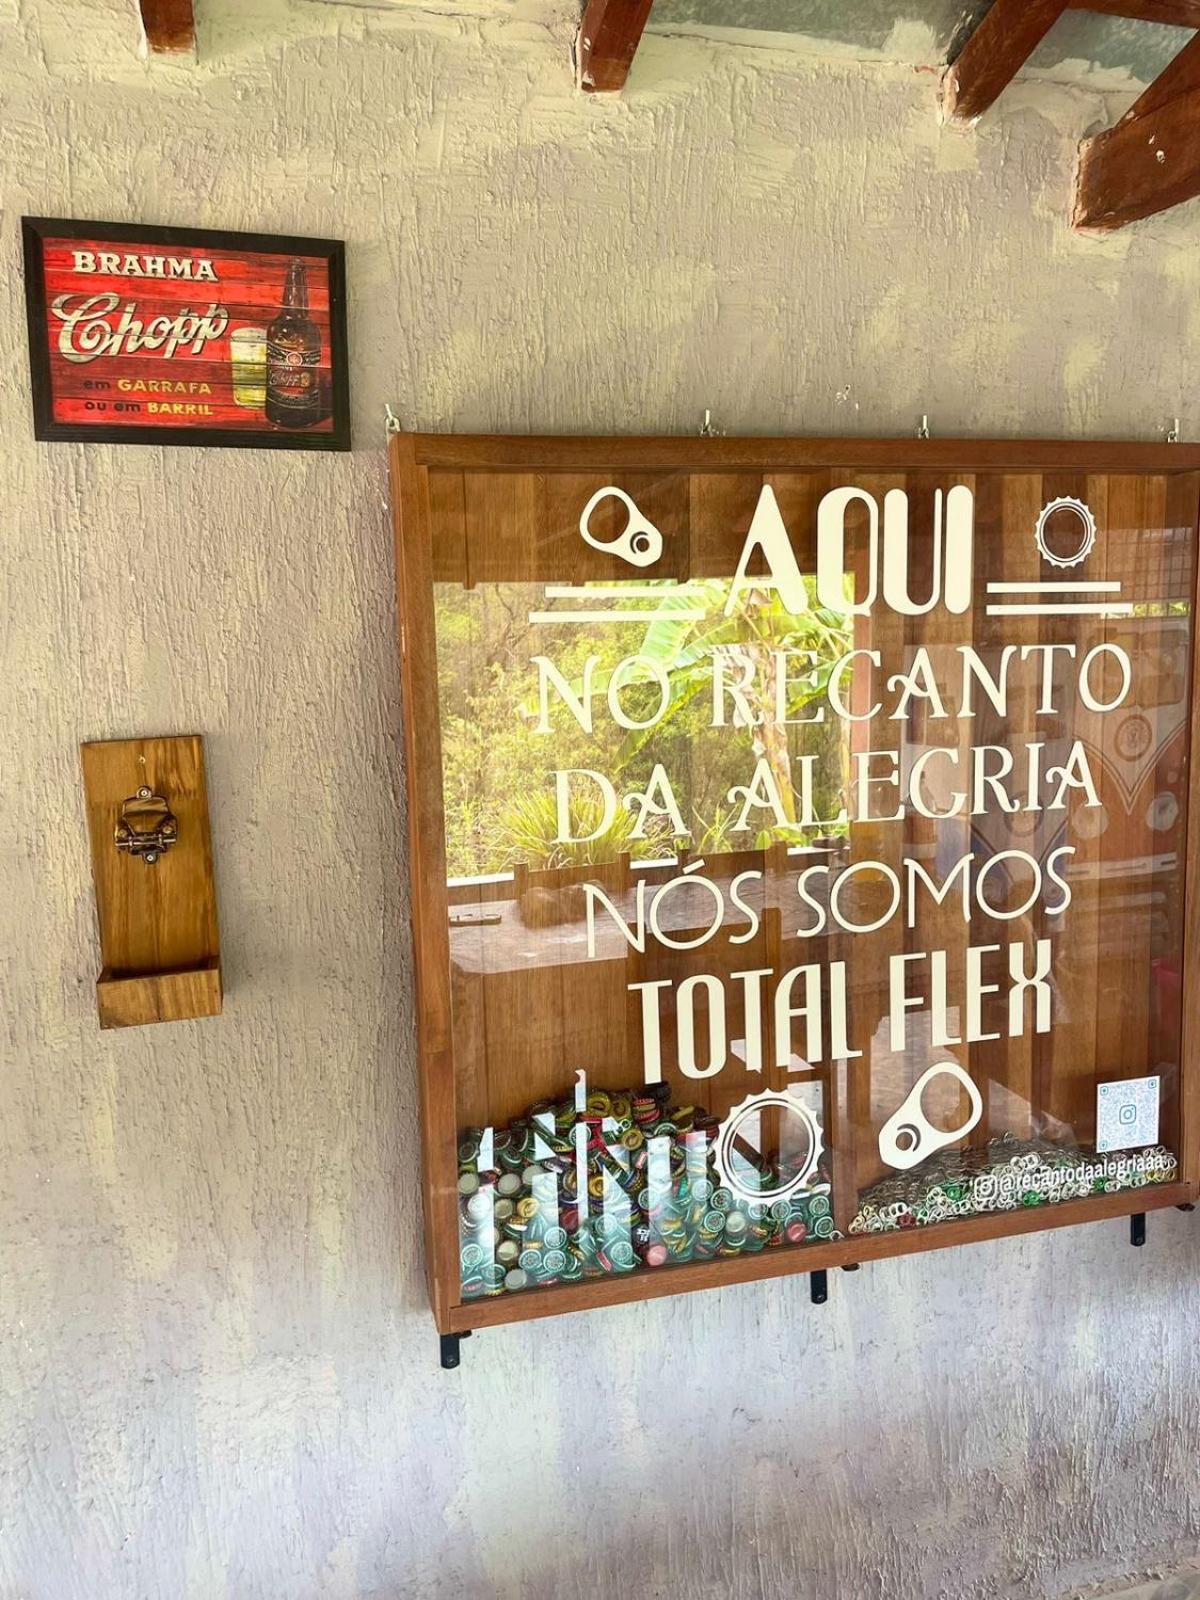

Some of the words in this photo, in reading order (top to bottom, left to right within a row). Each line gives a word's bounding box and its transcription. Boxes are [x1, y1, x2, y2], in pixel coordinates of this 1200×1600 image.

[71, 250, 219, 282] BRAHMA
[51, 292, 230, 364] Chopp
[84, 380, 111, 390] em
[117, 379, 212, 394] GARRAFA
[84, 401, 107, 412] ou
[114, 402, 141, 412] em
[147, 402, 214, 415] BARRIL
[724, 484, 974, 616] AQUI
[530, 655, 672, 734] NO
[707, 642, 1132, 728] RECANTO
[553, 763, 693, 844] DA
[727, 740, 1103, 832] ALEGRIA
[583, 859, 763, 958] NÓS
[797, 846, 1076, 939] SOMOS
[627, 960, 863, 1084] TOTAL
[889, 939, 1052, 1053] FLEX
